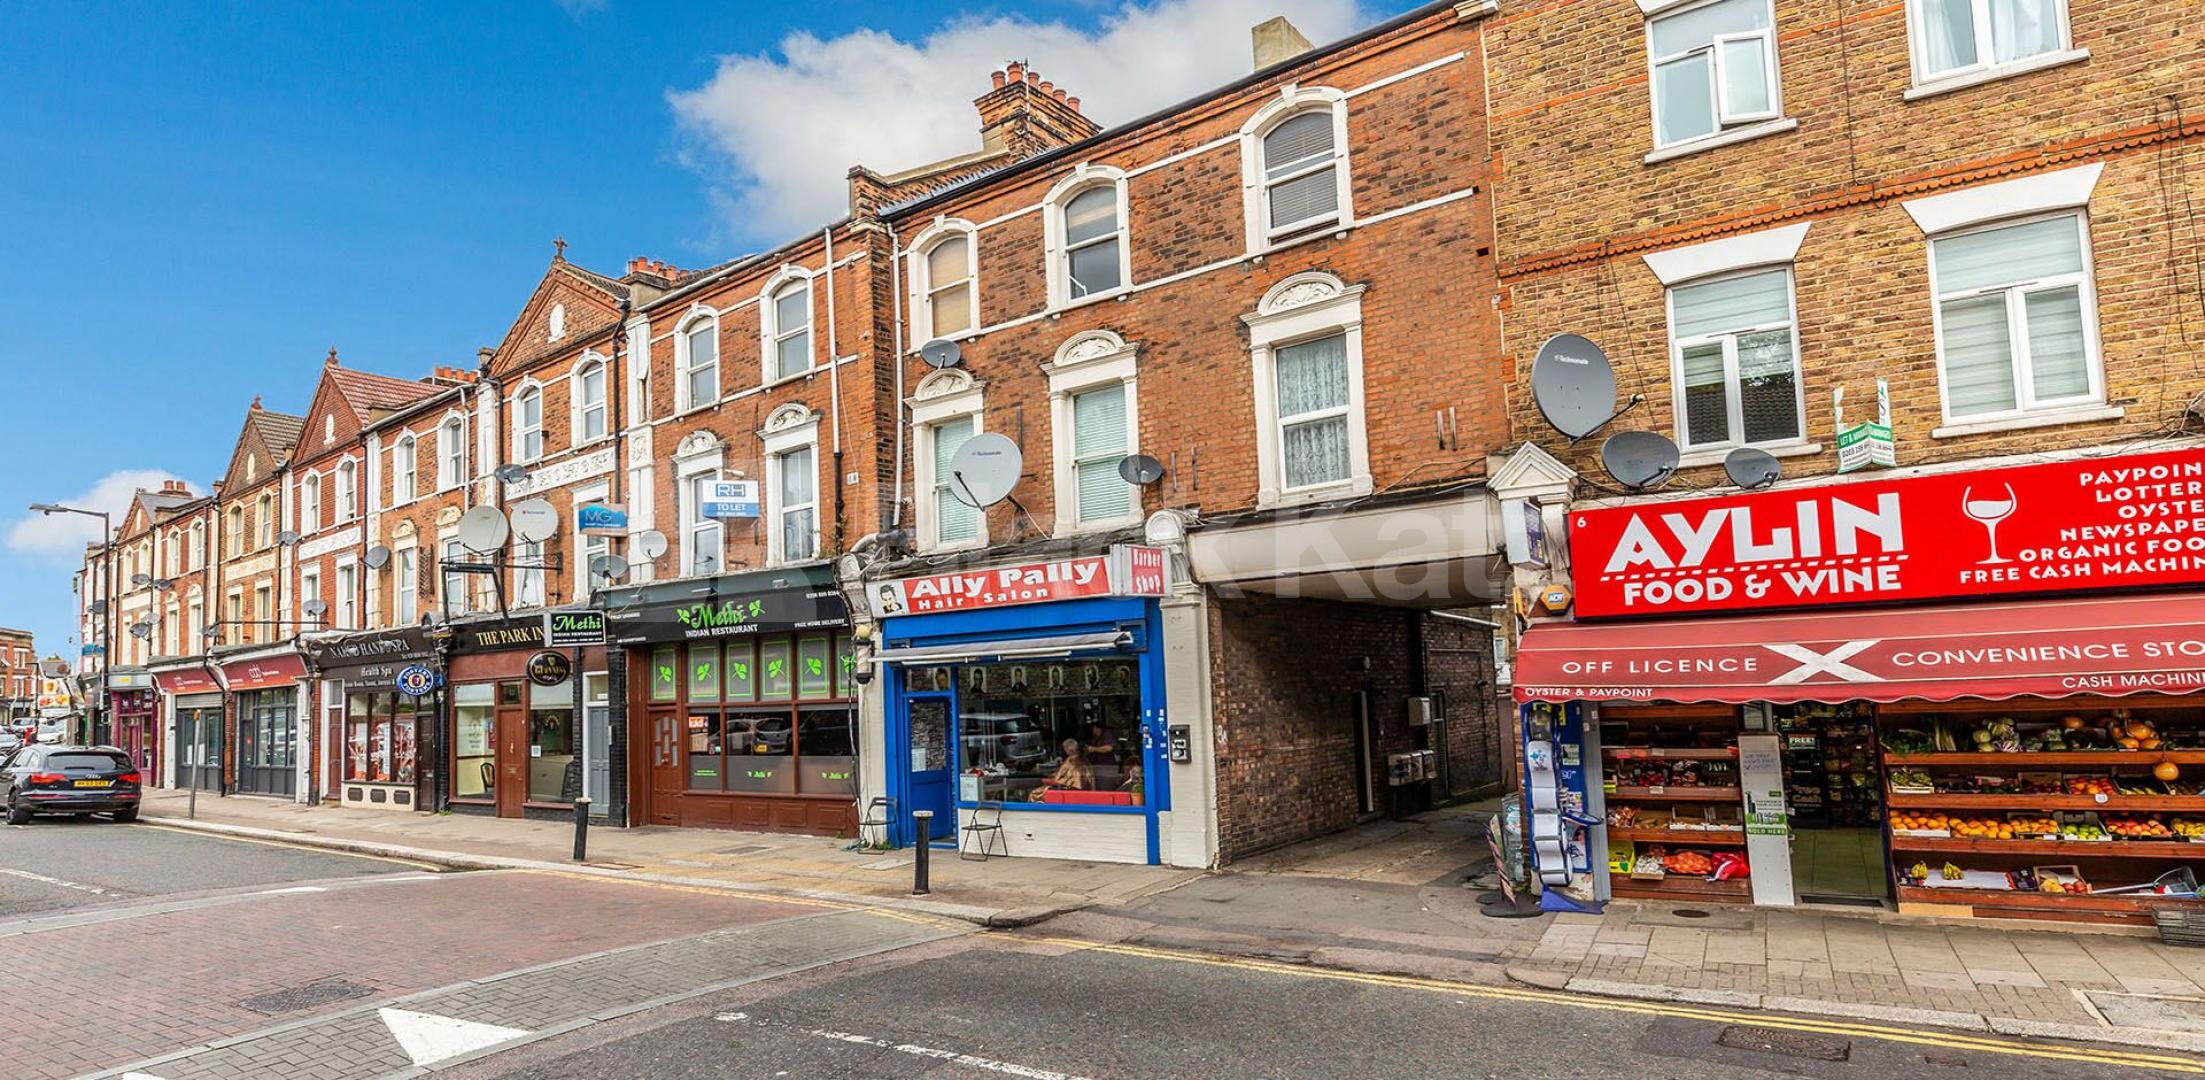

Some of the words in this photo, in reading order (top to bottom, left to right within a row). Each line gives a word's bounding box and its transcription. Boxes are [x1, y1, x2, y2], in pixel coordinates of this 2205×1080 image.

[2079, 462, 2202, 487] PAYPOIN
[717, 484, 745, 497] RH
[2096, 482, 2202, 503] LOTTER
[2118, 499, 2205, 519] OYSTE
[1576, 516, 1587, 528] 6
[2060, 518, 2205, 542] NEWSPAPE
[1604, 493, 1904, 573] AYLIN
[1134, 548, 1162, 568] Barber
[2019, 541, 2137, 563] ORGANIC
[2147, 536, 2205, 555] FOO
[911, 576, 986, 599] Ally
[999, 561, 1100, 588] Pally
[1960, 567, 2021, 584] FREE
[2029, 563, 2091, 580] CASH
[1136, 574, 1162, 595] Shop
[1624, 576, 1733, 607] FOOD
[1744, 573, 1771, 599] &
[1781, 565, 1901, 597] WINE
[918, 597, 964, 611] Hair
[983, 587, 1048, 604] Salon
[552, 615, 602, 631] Methi
[691, 601, 748, 629] Methi
[476, 631, 500, 646] THE
[500, 628, 530, 644] PARK
[685, 628, 710, 638] INDIAN
[711, 624, 758, 636] RESTAURANT
[1892, 642, 2129, 667] CONVENIENCE
[2143, 640, 2205, 658] STO
[1562, 661, 1614, 675] OFF
[1629, 657, 1758, 674] LICENCE
[2062, 675, 2113, 689] CASH
[1525, 688, 1570, 698] OYSTER
[1576, 688, 1585, 697] &
[1589, 688, 1655, 698] PAYPOINT
